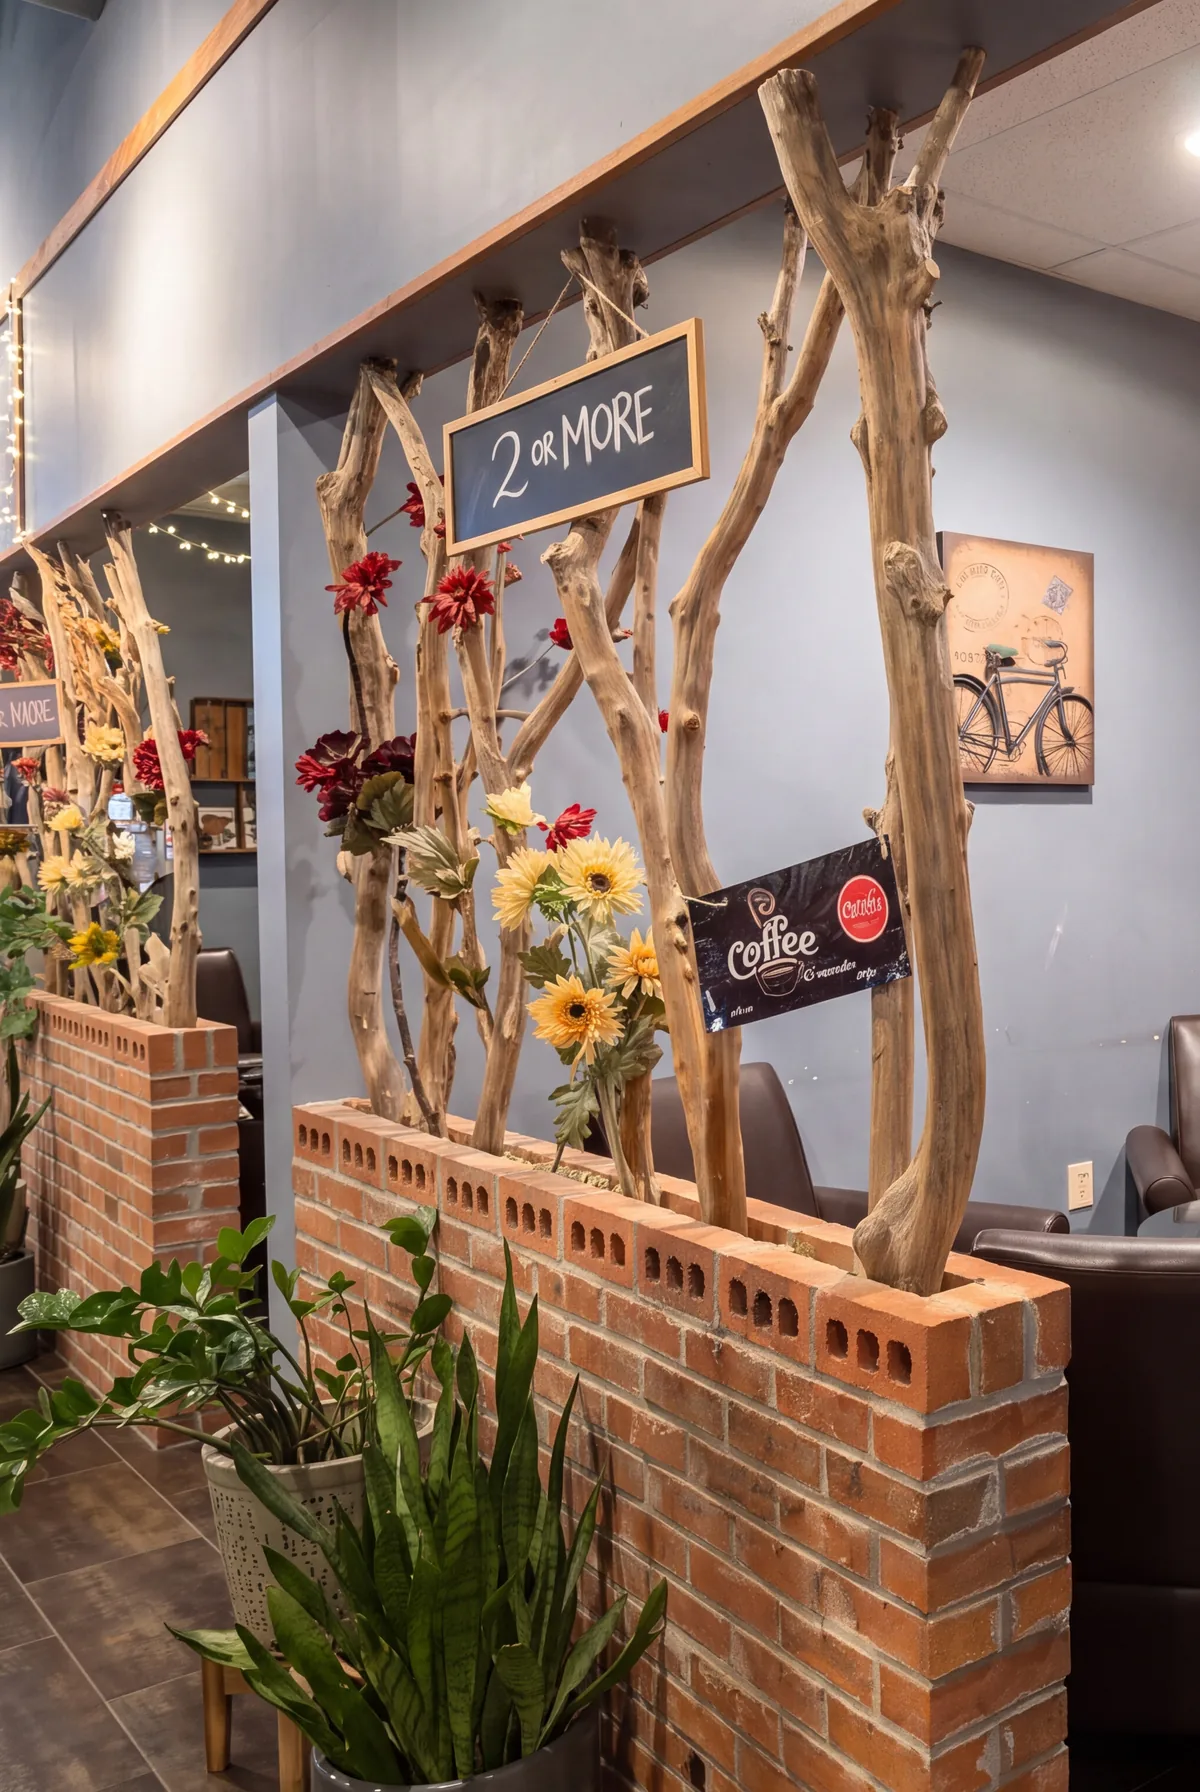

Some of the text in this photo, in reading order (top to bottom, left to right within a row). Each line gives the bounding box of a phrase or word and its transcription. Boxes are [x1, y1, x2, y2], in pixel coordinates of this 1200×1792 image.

[491, 384, 655, 508] 2 OR MORE
